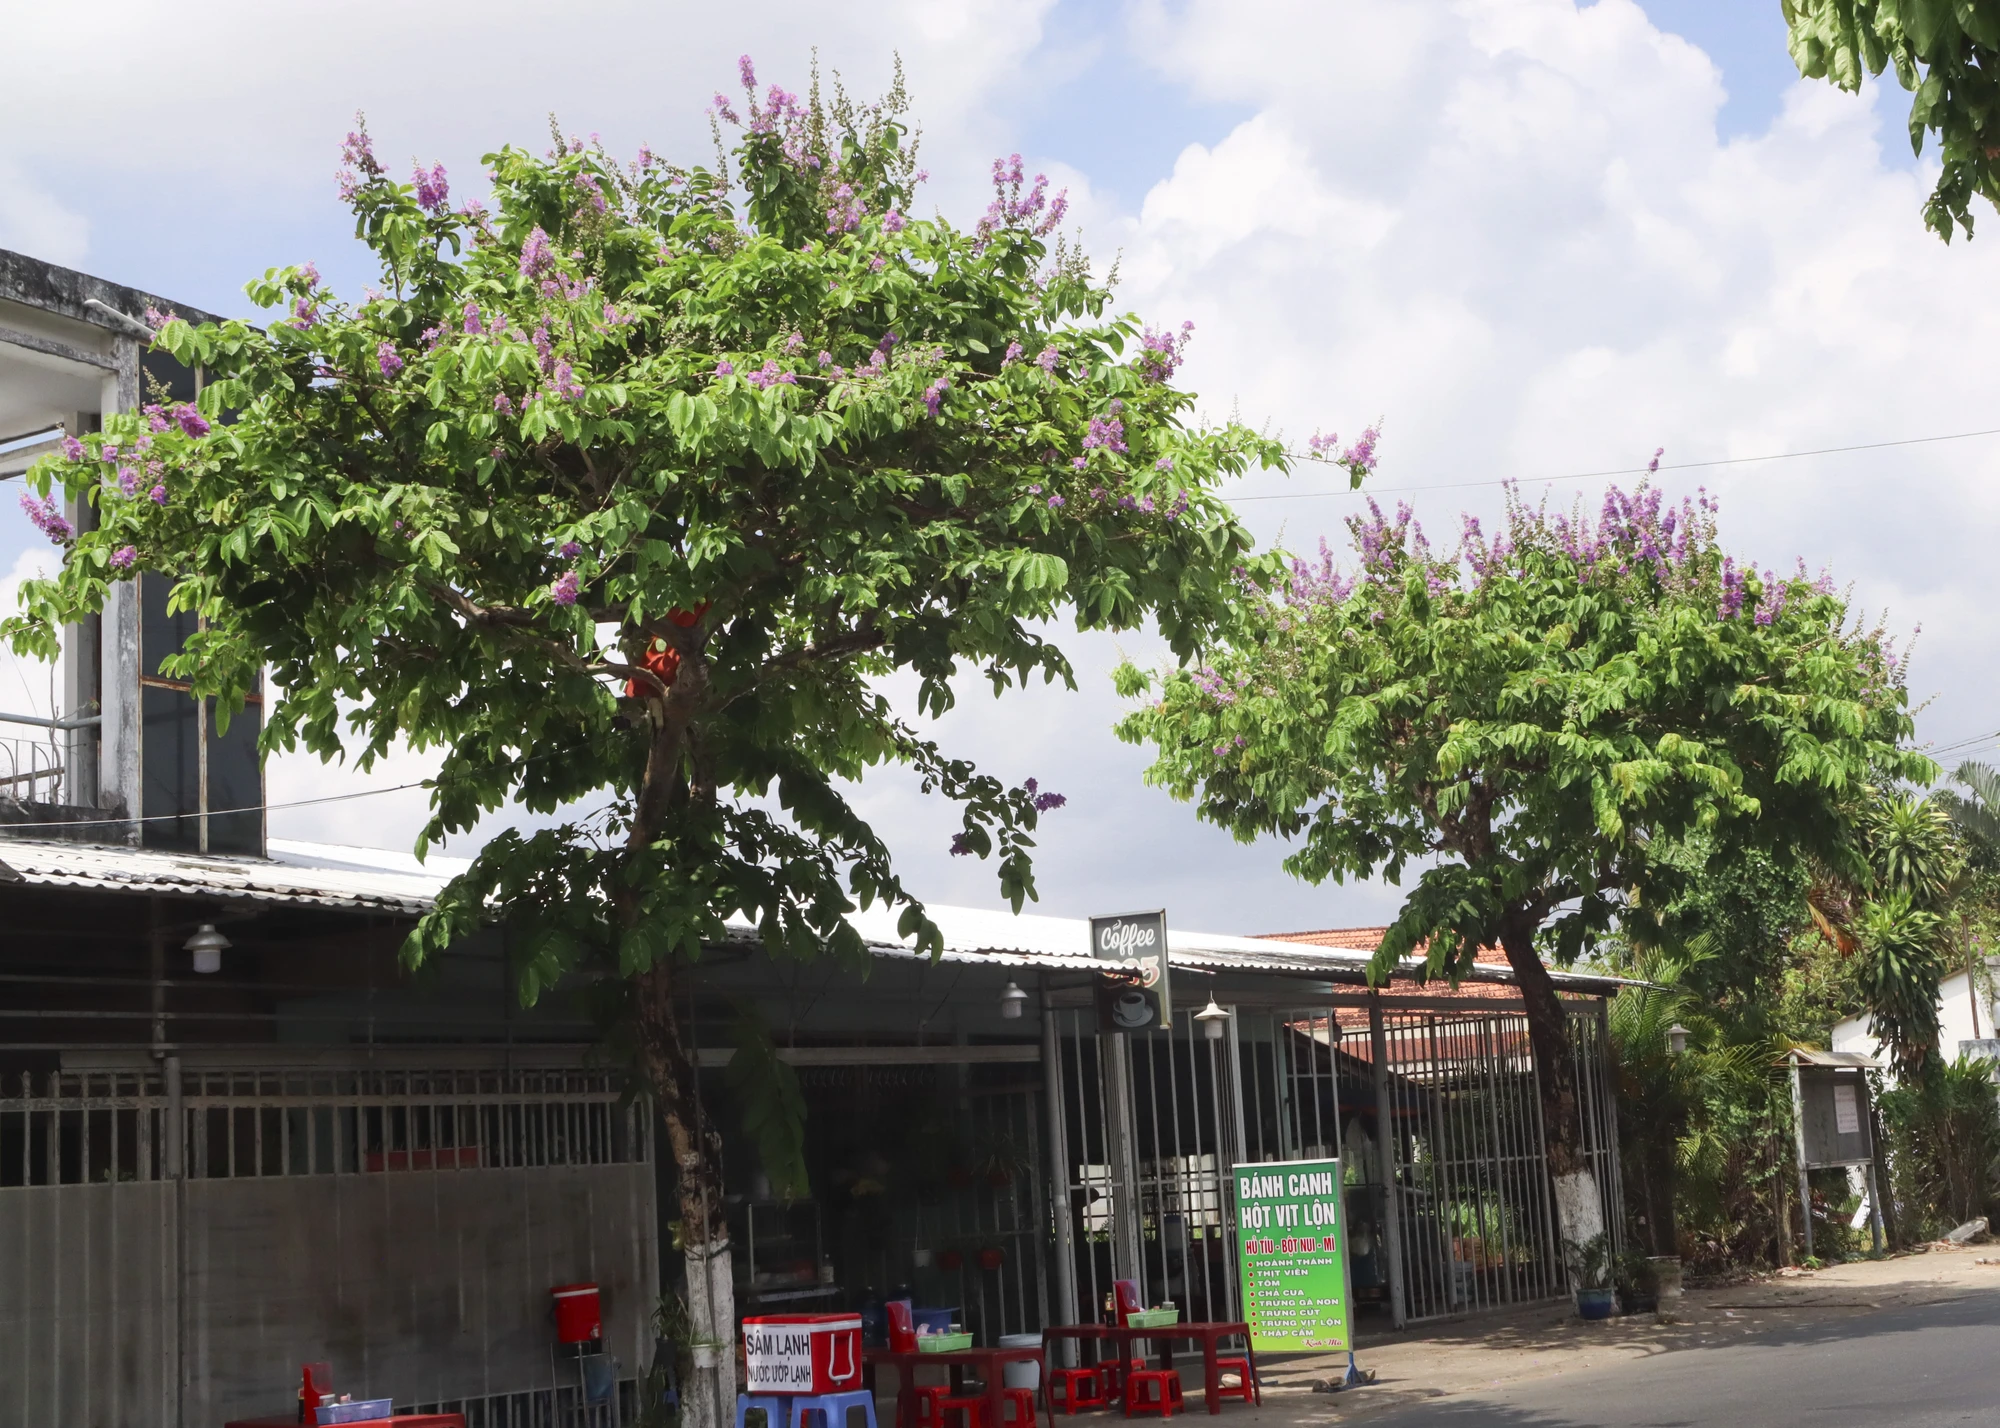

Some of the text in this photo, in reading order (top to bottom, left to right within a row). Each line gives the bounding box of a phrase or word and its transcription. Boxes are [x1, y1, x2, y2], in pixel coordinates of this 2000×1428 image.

[1101, 922, 1155, 956] Coffee
[1240, 1172, 1332, 1199] BÁNH CANH
[1241, 1198, 1335, 1233] HỘT VỊT LỘN
[1245, 1235, 1258, 1255] HỦ
[1281, 1235, 1298, 1257] BỘT
[1299, 1237, 1316, 1253] NUI
[1256, 1256, 1332, 1267] HOÀNH THÁNH
[1257, 1268, 1308, 1278] THỊT VIÊN
[1257, 1279, 1280, 1287] TÔM
[1259, 1297, 1339, 1307] TRỨNG GÀ NON
[1259, 1307, 1320, 1317] TRỨNG CÚT
[1260, 1317, 1341, 1328] TRỨNG VỊT LỘN
[1261, 1328, 1289, 1338] THẬP
[747, 1329, 810, 1361] SÂM LẠNH
[748, 1360, 811, 1387] NƯỚC ƯỚP LẠNH
